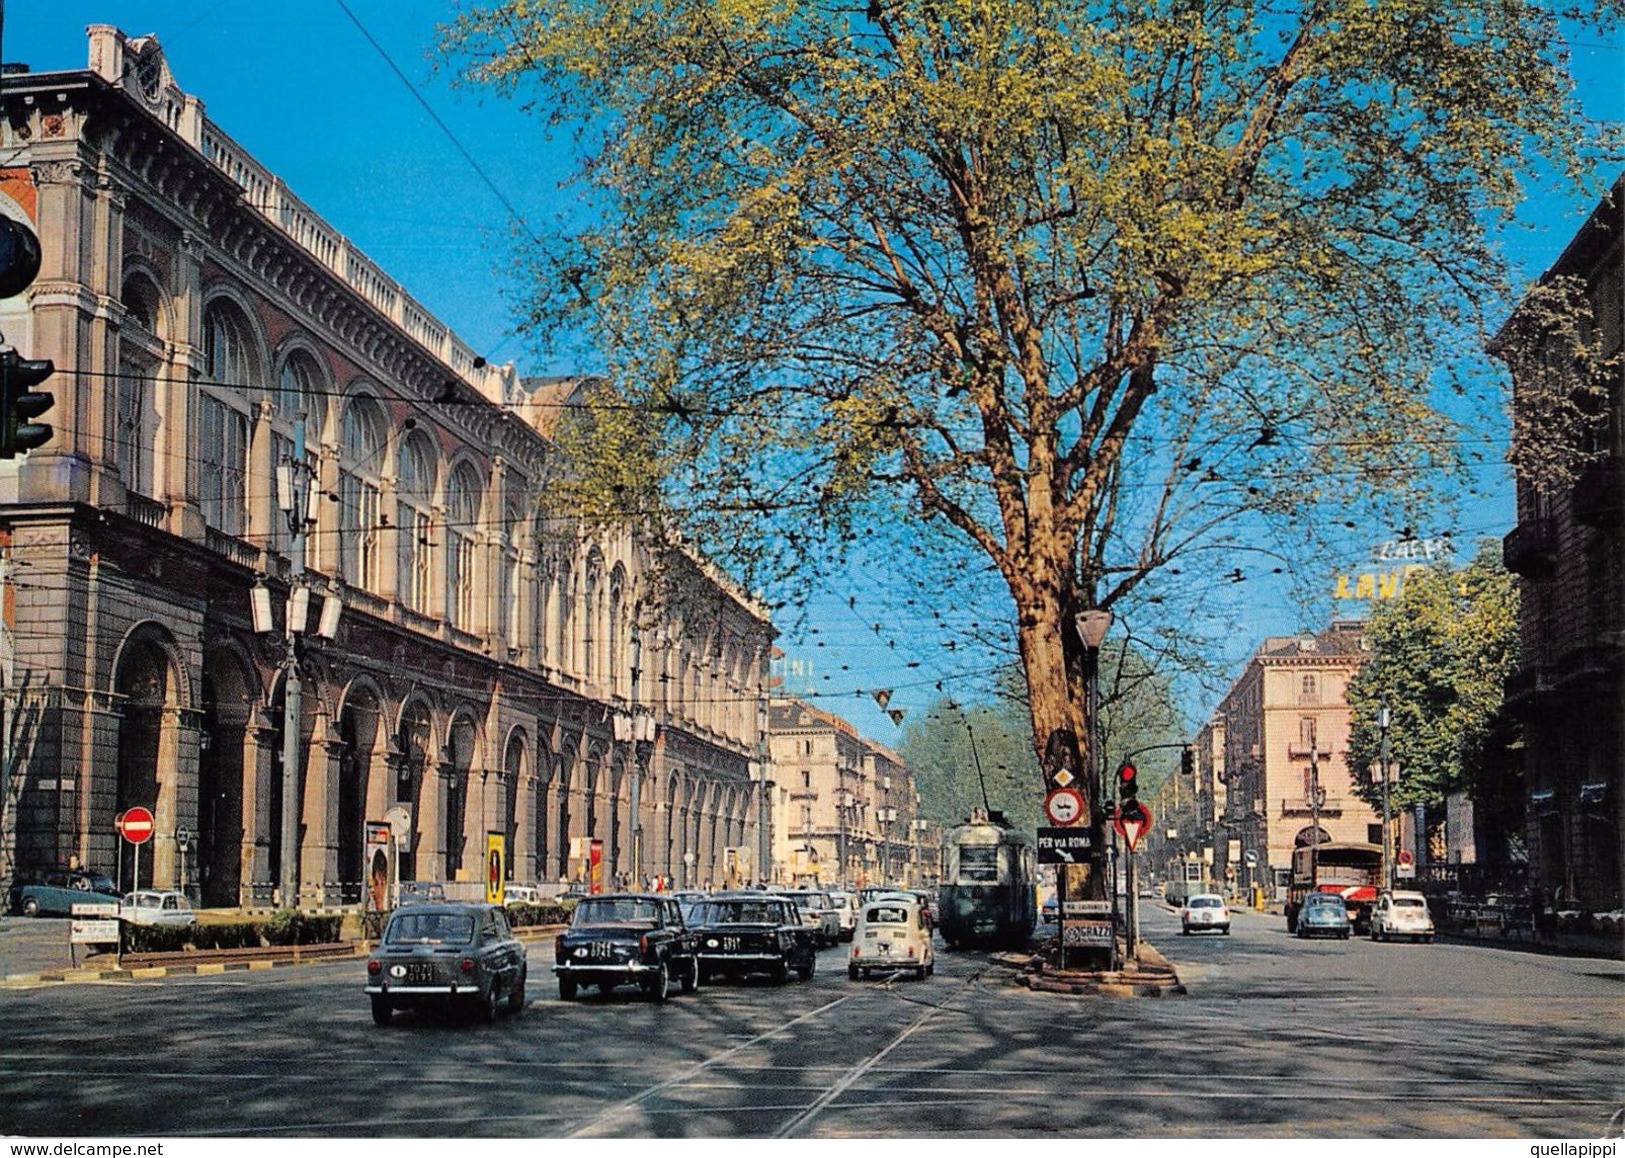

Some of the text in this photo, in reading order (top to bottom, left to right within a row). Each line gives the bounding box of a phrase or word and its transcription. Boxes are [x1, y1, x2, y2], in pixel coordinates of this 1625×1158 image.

[1039, 837, 1091, 848] PER VIA ROMA
